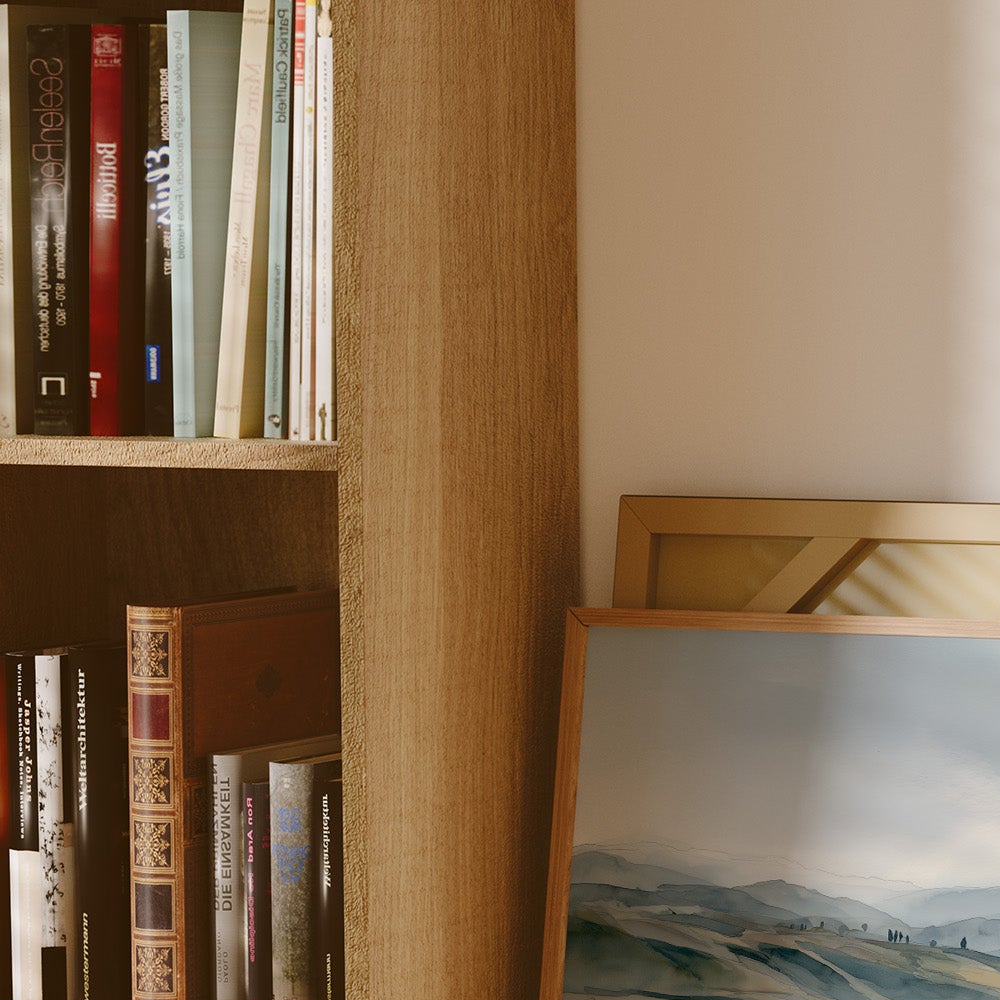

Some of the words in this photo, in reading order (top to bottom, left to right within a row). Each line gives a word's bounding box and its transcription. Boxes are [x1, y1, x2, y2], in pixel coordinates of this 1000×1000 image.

[23, 699, 33, 751] Jasper
[78, 669, 86, 811] Weltarchitektur
[25, 757, 34, 802] Johns
